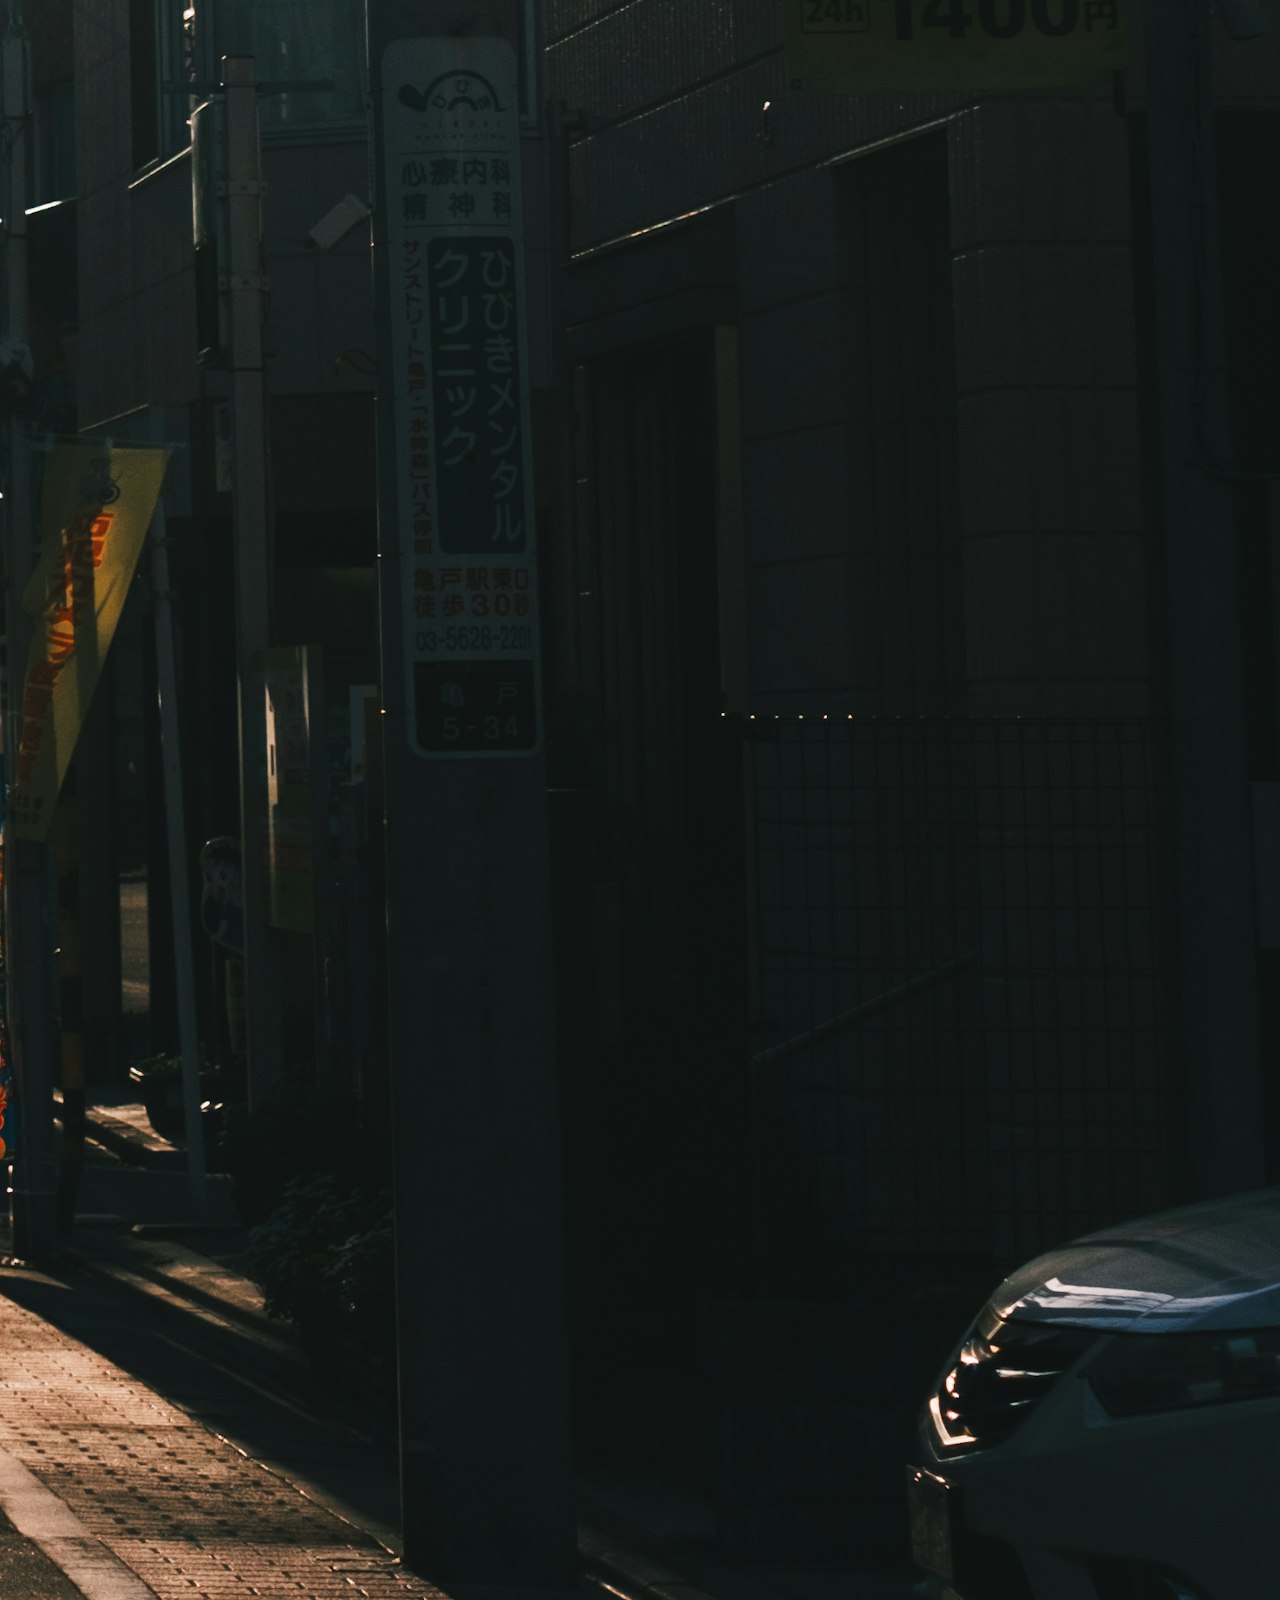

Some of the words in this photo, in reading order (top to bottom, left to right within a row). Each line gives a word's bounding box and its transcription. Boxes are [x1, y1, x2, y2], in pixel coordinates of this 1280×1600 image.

[401, 158, 510, 187] 心療内科
[402, 191, 512, 221] 精神科
[433, 247, 477, 467] クリニック
[479, 248, 522, 543] ひびきメンタル
[414, 567, 529, 592] 亀戸駅東口
[414, 593, 529, 617] 徒歩30秒
[415, 625, 532, 651] 03-5628-2201
[442, 715, 519, 740] 5-34
